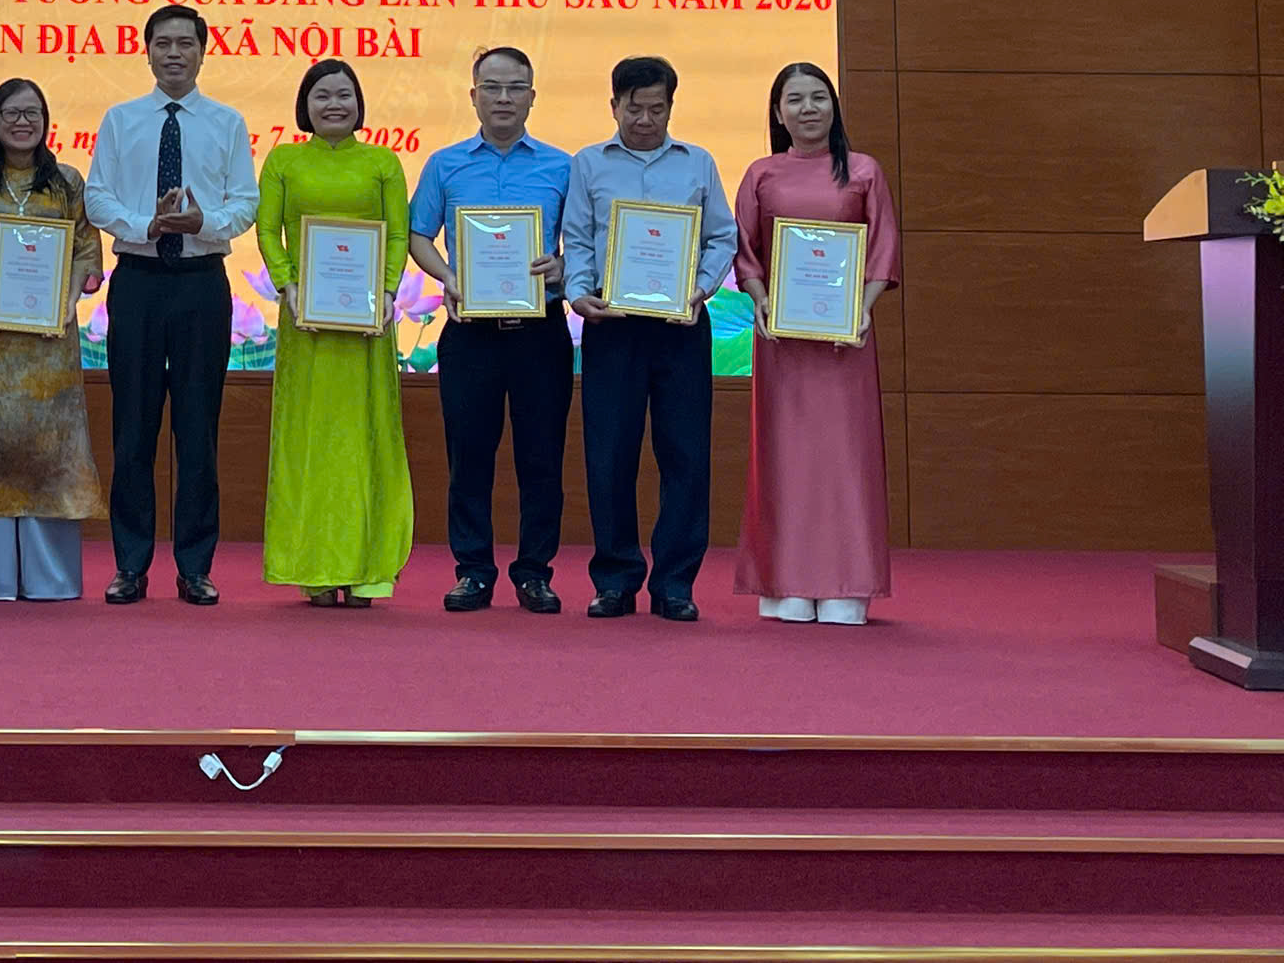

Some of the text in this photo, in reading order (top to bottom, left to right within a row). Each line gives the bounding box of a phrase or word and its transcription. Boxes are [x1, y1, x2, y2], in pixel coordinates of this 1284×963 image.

[37, 24, 106, 64] ĐỊA
[206, 18, 261, 56] XÃ
[272, 21, 343, 66] NỘI
[355, 17, 421, 58] BÀI
